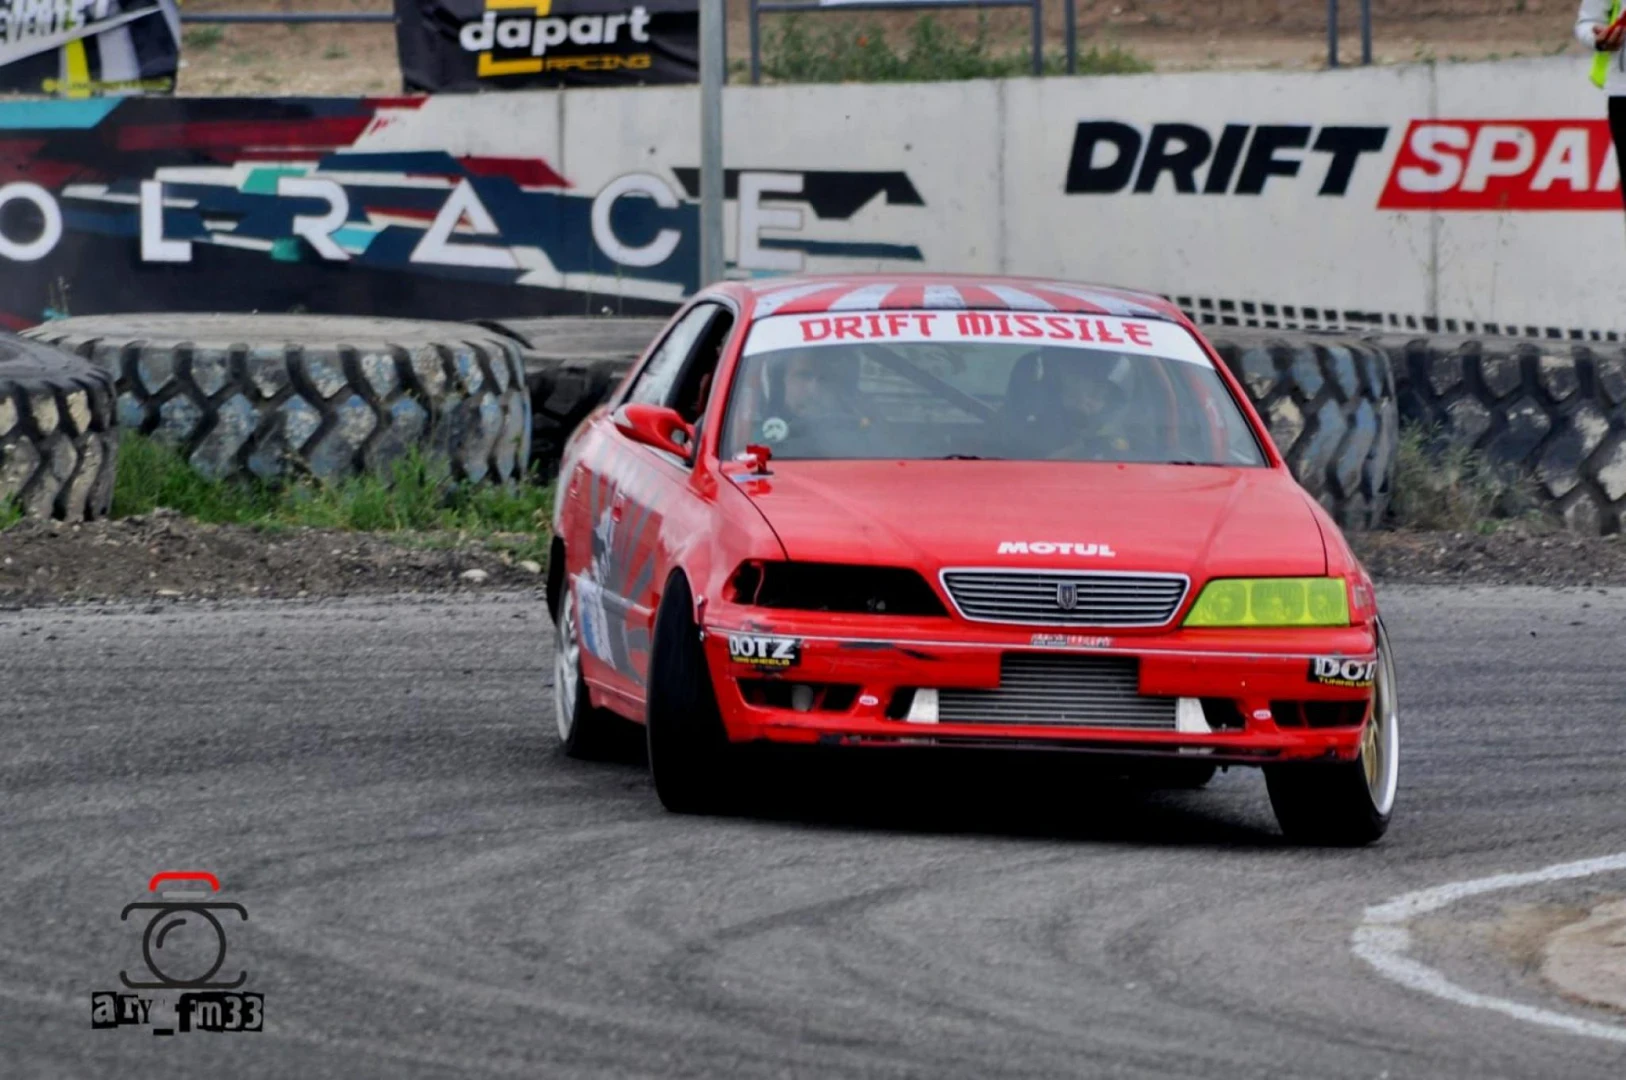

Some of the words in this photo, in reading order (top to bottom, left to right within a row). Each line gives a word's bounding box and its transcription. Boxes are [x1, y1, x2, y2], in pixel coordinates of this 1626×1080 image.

[459, 6, 650, 56] dapart
[545, 54, 650, 71] RACING
[1065, 121, 1389, 195] DRIFT
[799, 313, 936, 342] DRIFT
[956, 311, 1153, 346] MISSILE
[997, 541, 1116, 557] MOTUL
[729, 635, 796, 659] DOTZ
